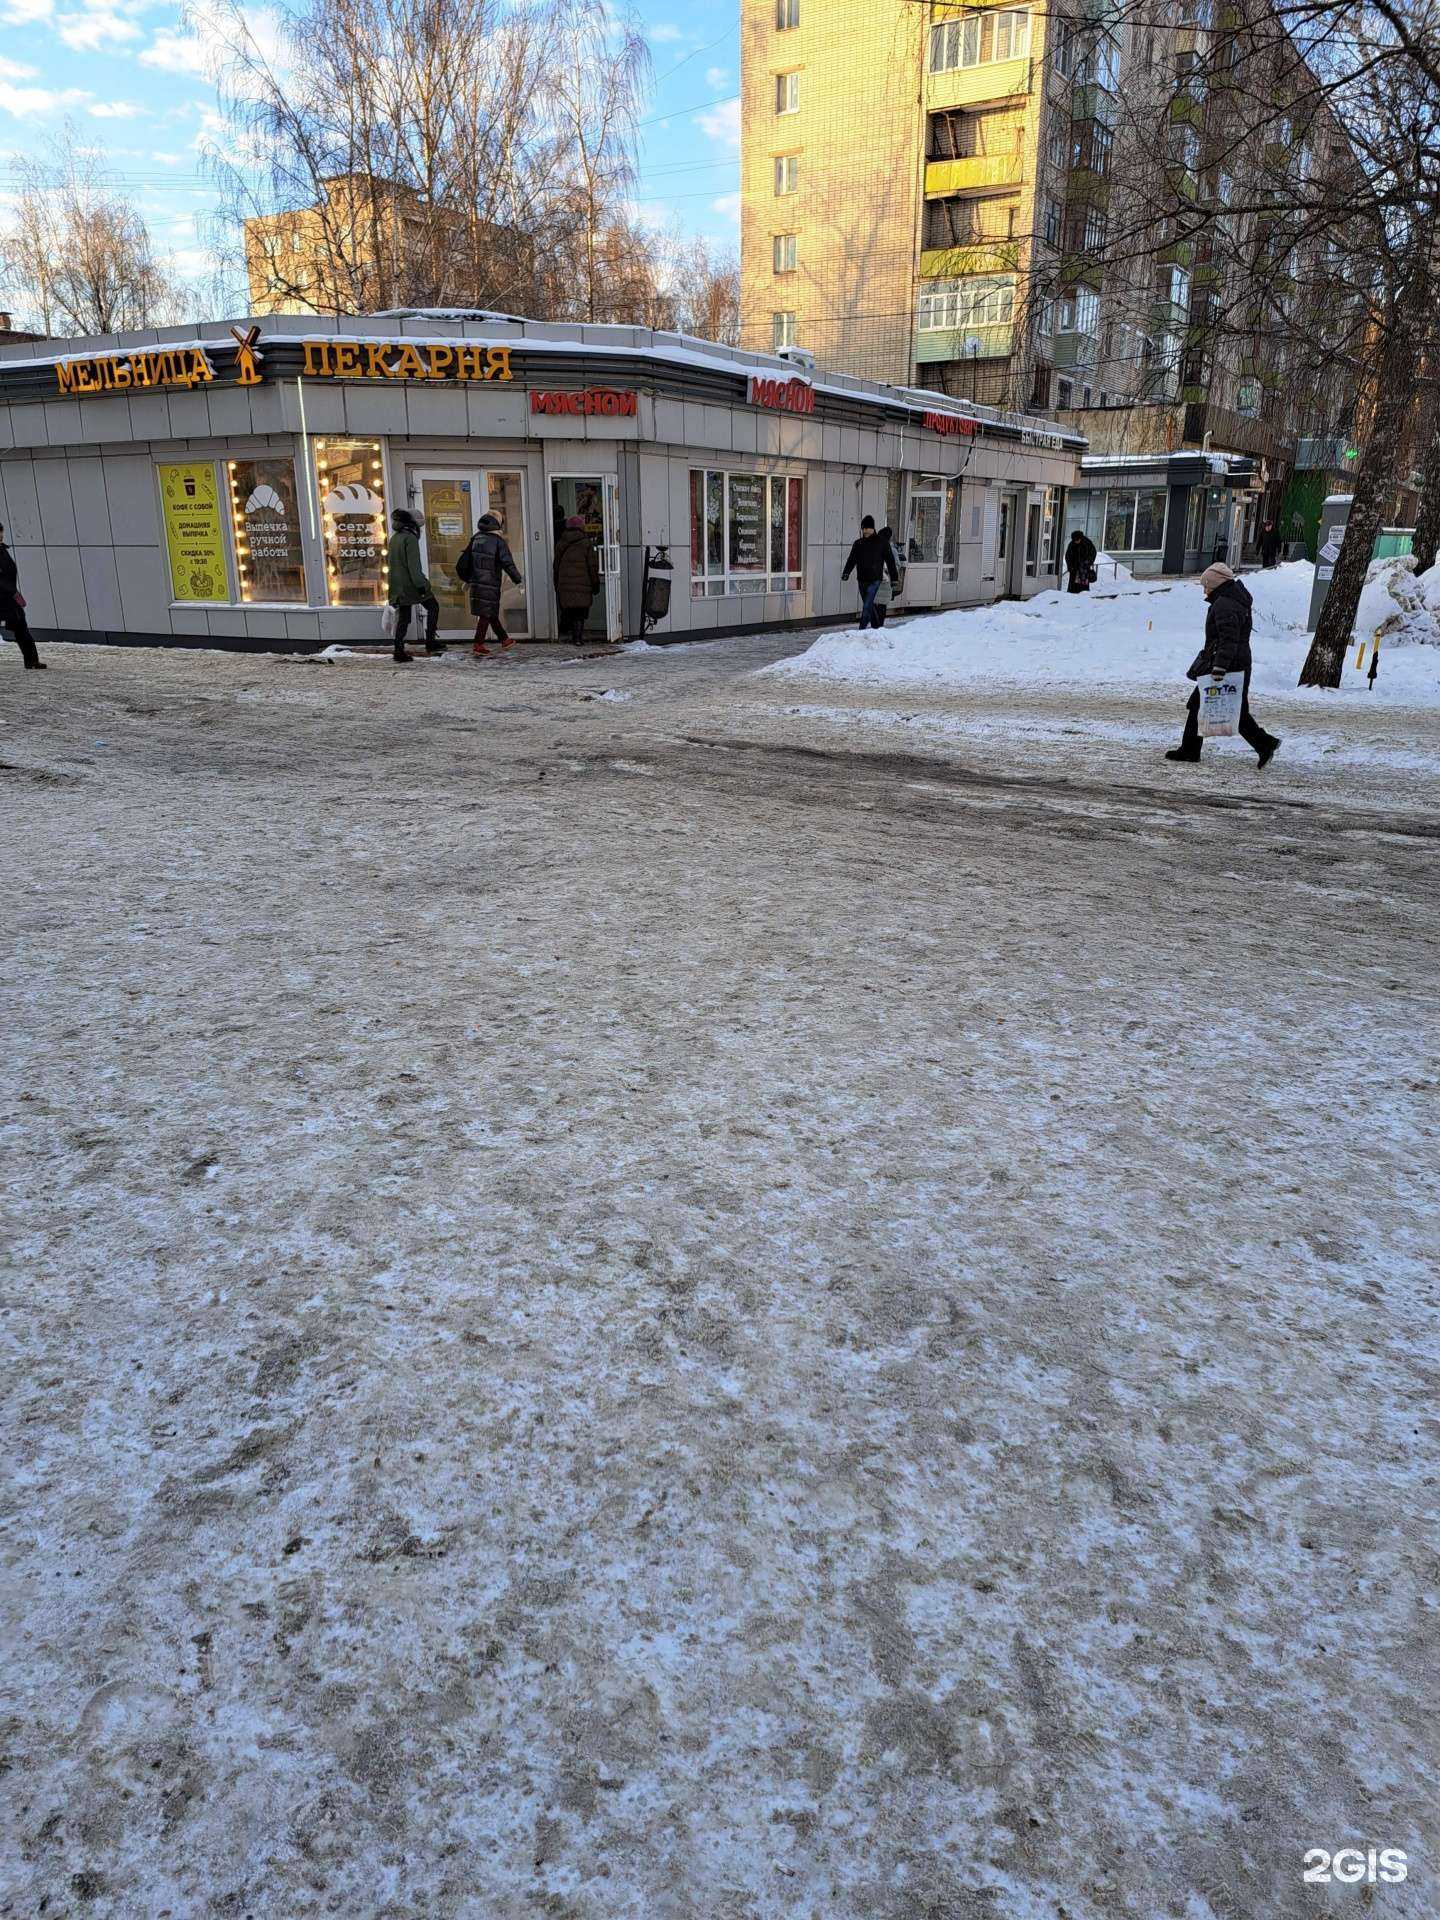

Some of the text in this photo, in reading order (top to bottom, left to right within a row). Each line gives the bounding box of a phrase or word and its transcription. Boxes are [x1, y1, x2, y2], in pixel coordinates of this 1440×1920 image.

[54, 348, 214, 393] МЕЛЬНИЦА
[302, 342, 514, 381] ПЕКАРНЯ
[529, 386, 637, 417] МЯСНОЙ
[752, 376, 816, 415] МЯСНОЙ
[245, 522, 288, 532] Выпечка
[250, 533, 287, 548] ручной
[340, 546, 376, 557] хлеб
[251, 547, 289, 559] работы
